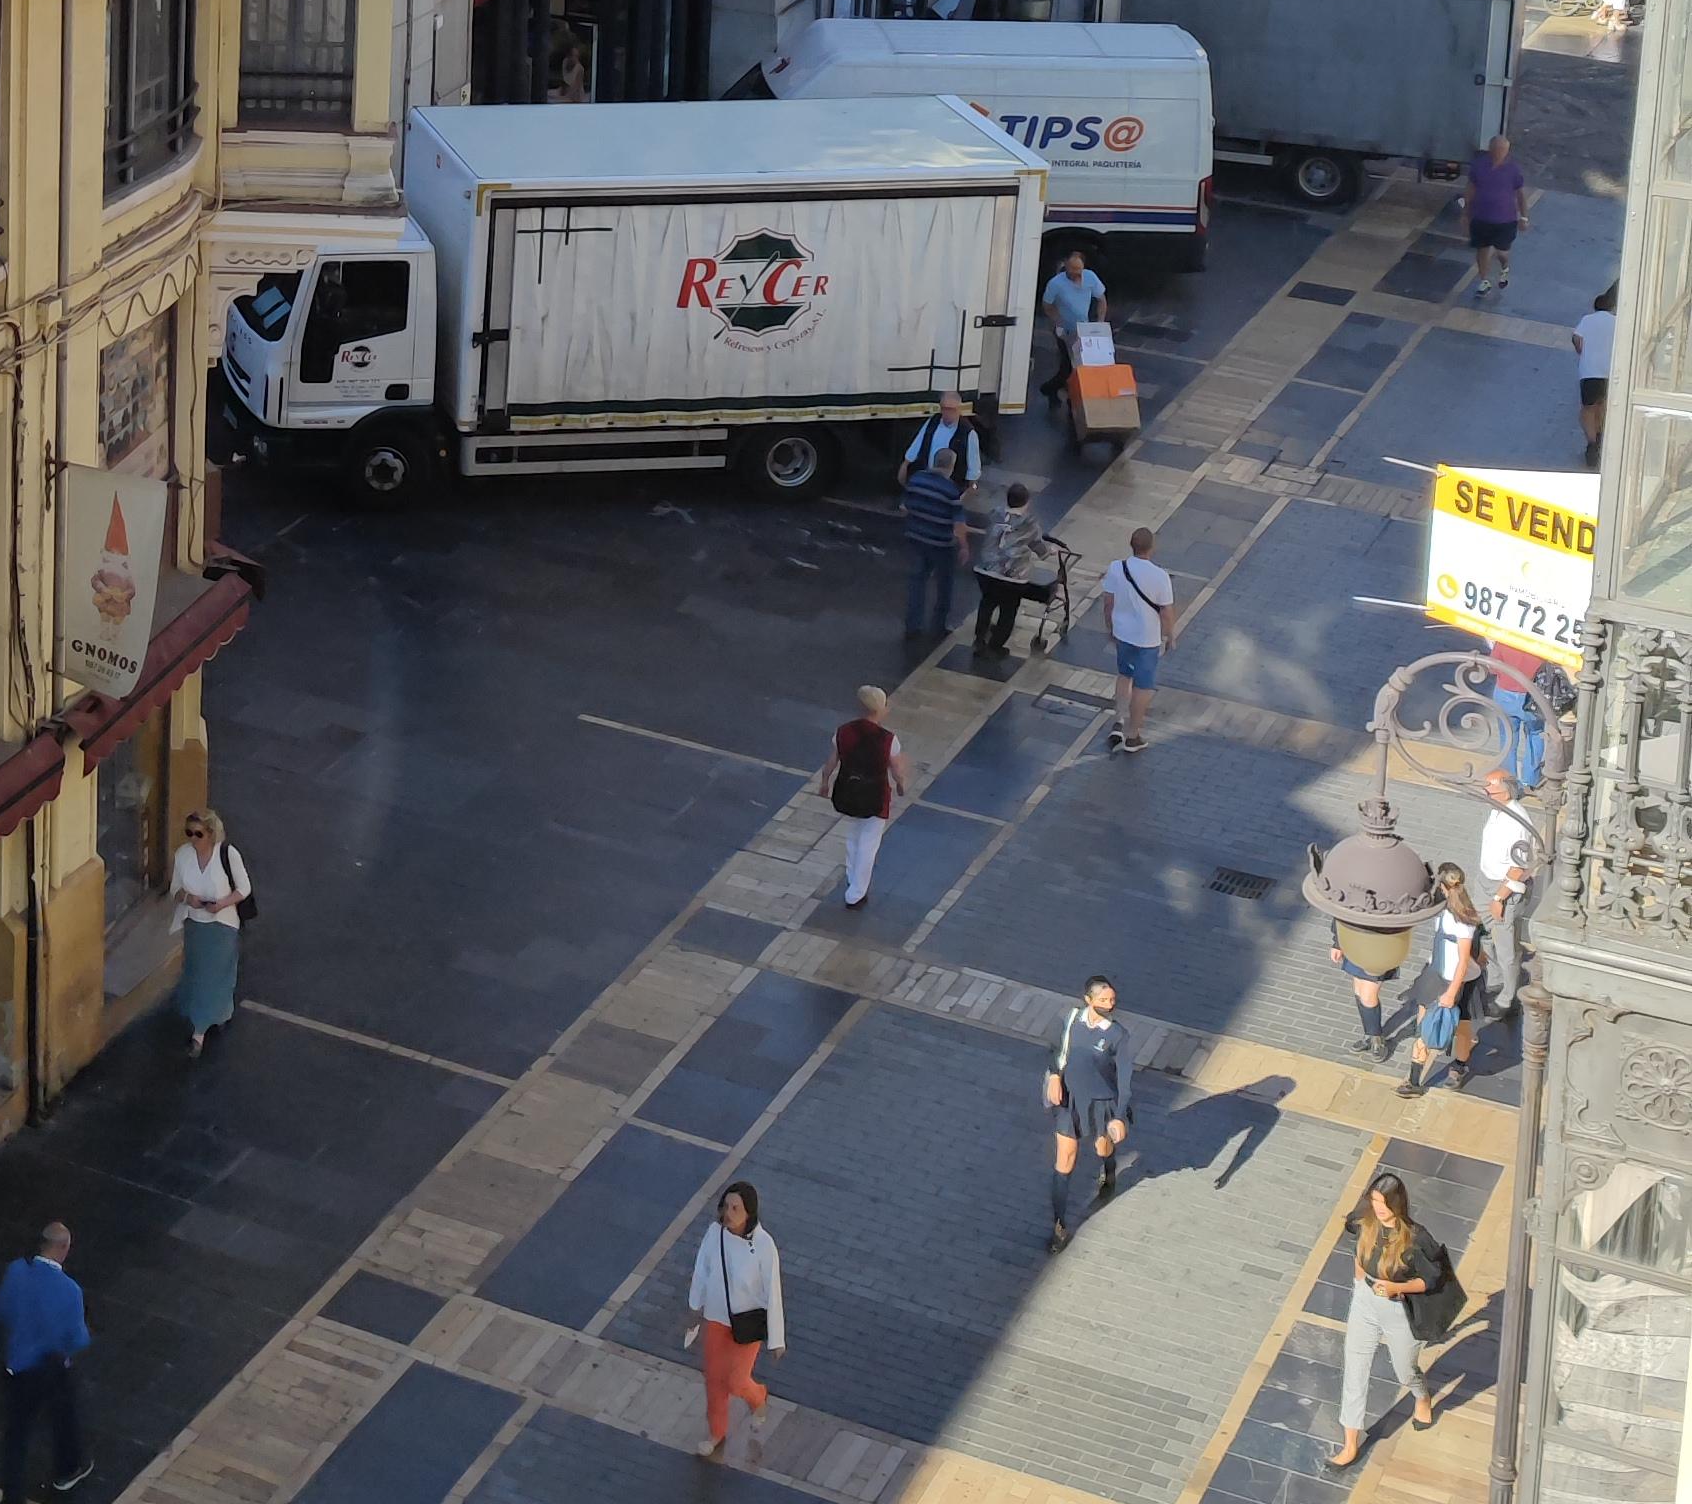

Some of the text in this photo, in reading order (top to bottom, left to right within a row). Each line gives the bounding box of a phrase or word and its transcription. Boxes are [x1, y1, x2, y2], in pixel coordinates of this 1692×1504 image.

[1051, 159, 1089, 168] INTEGRAL
[1454, 480, 1495, 523] SE
[1464, 581, 1508, 620] 987
[1517, 599, 1547, 635] 72
[71, 639, 138, 674] GNOMOS
